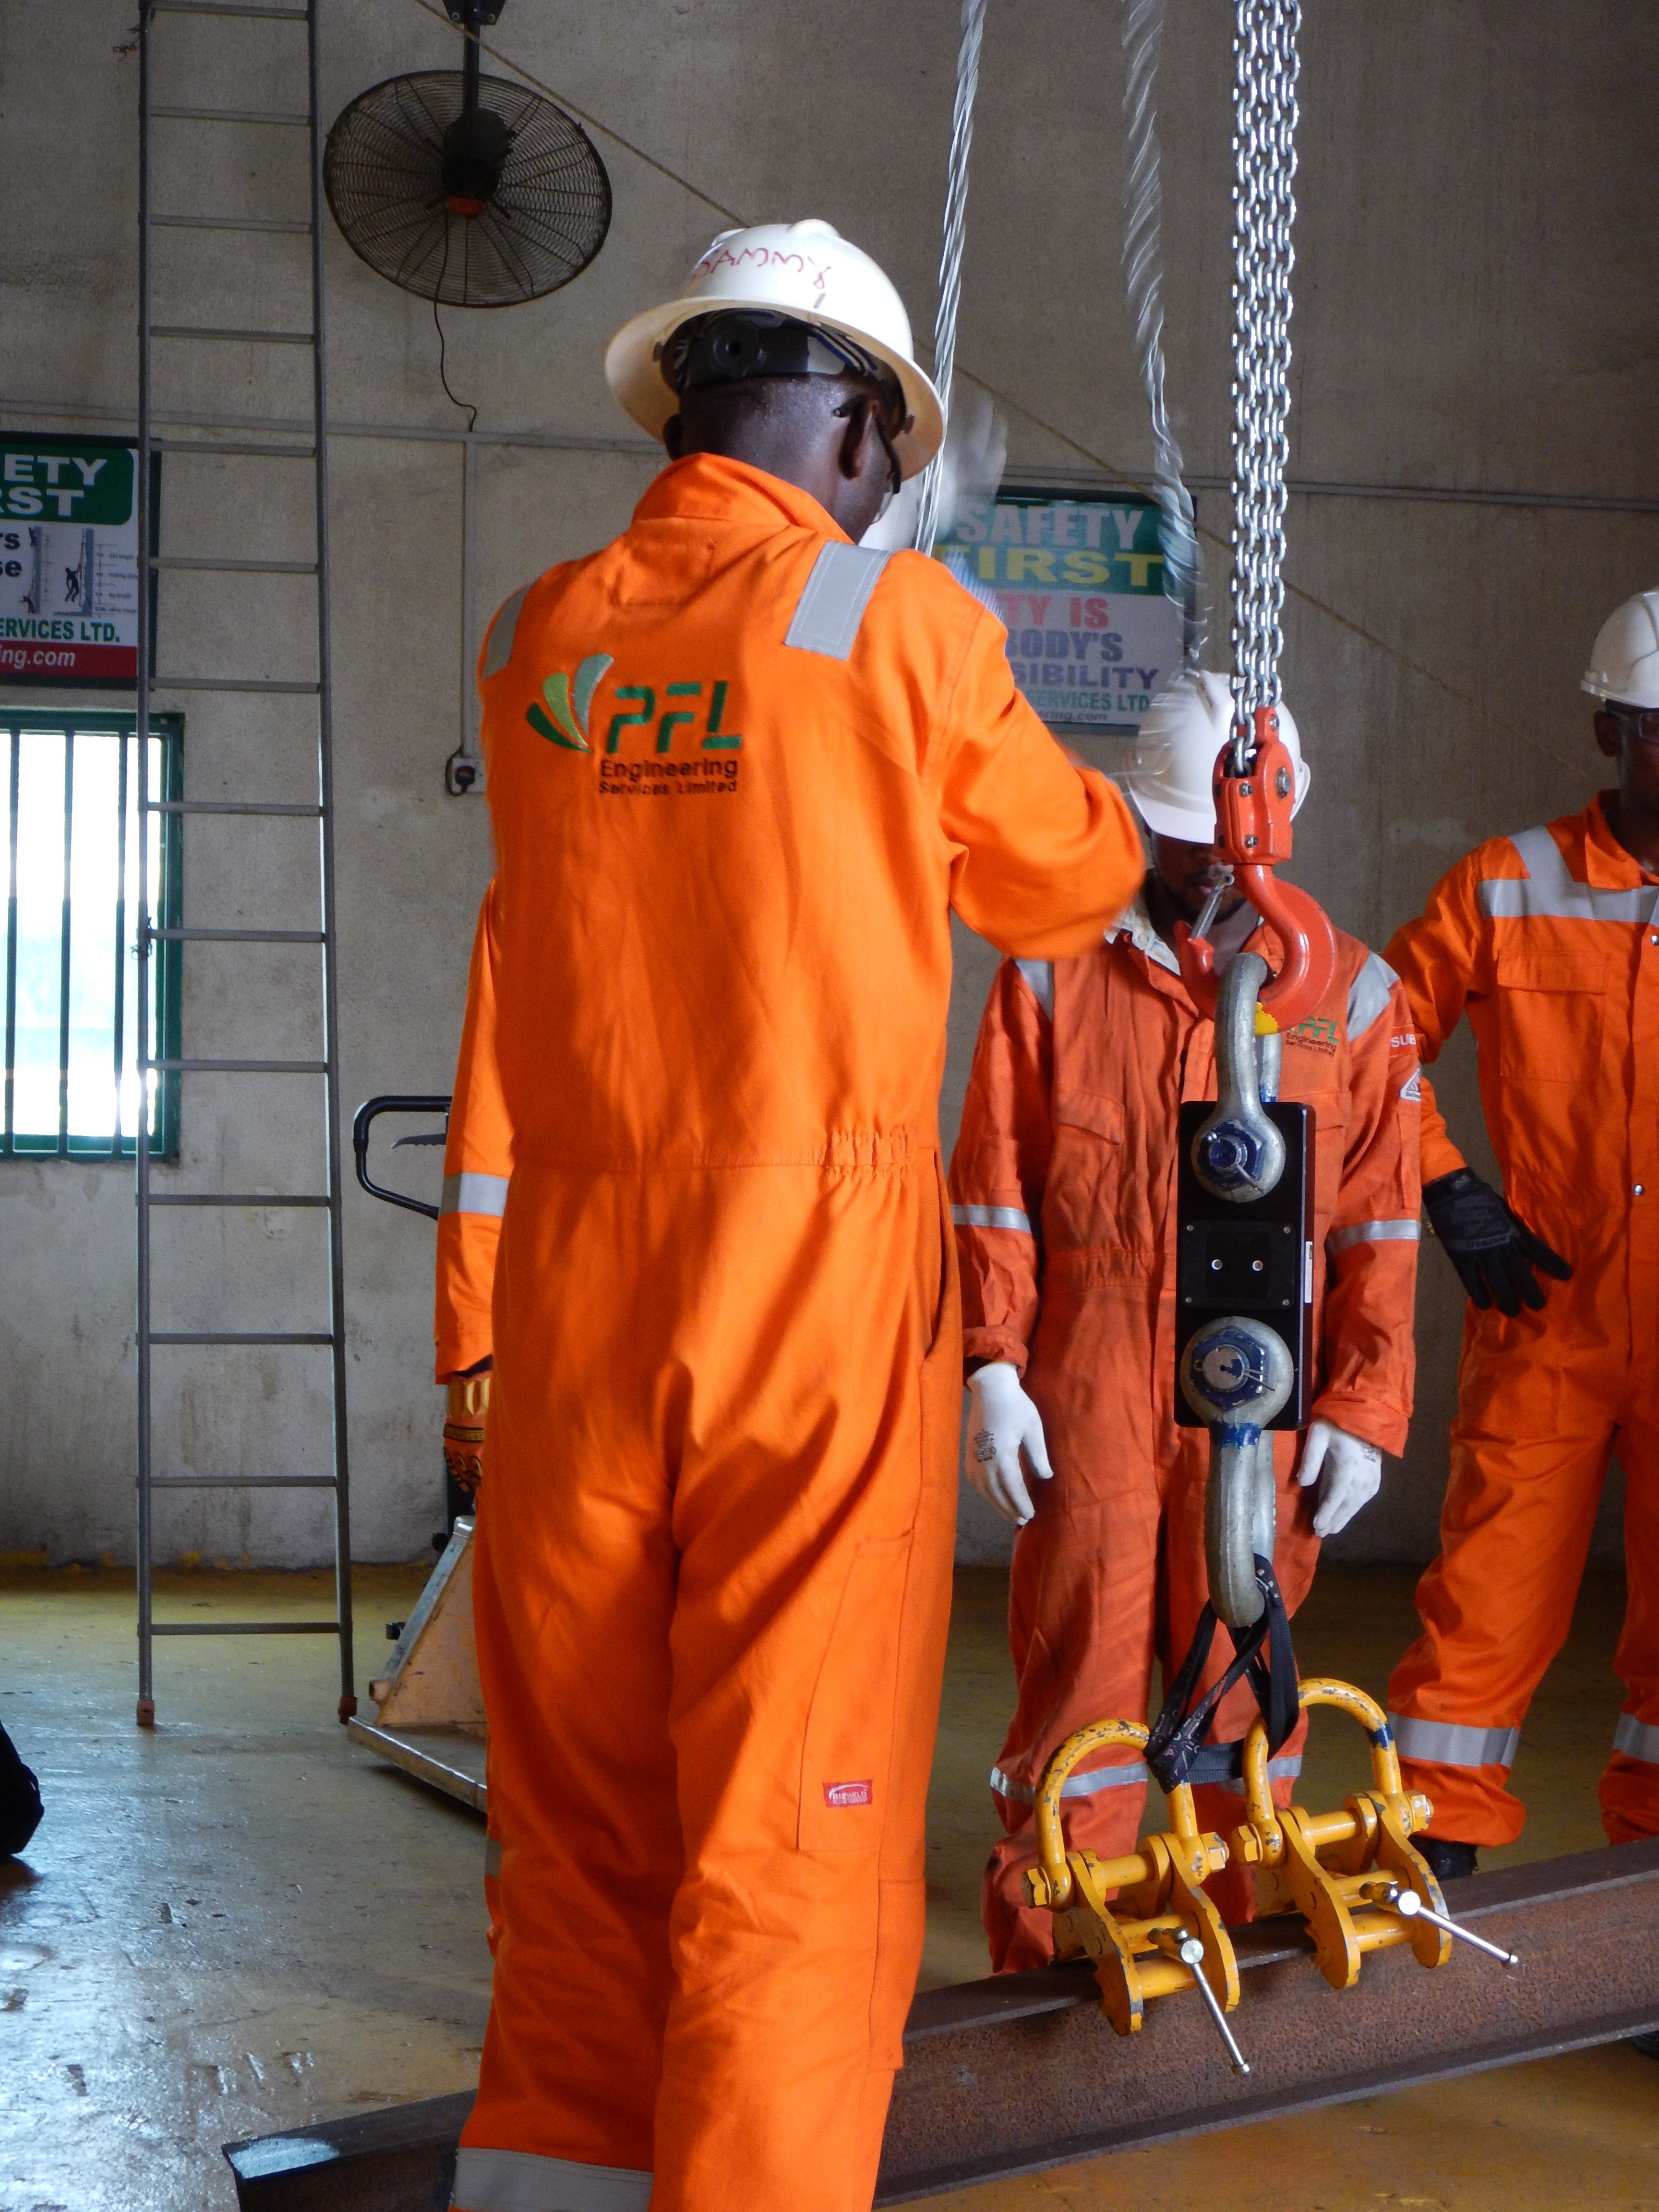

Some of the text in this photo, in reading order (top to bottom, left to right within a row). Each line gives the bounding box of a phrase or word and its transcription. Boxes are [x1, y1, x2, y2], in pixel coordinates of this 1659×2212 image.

[0, 486, 84, 517] ST
[956, 503, 1143, 550] SAFETY
[0, 560, 22, 577] e
[1070, 597, 1109, 630] IS
[81, 621, 120, 643] LTD.
[607, 680, 742, 754] PFL
[600, 757, 738, 782] Engineering
[1298, 1016, 1339, 1045] PFL
